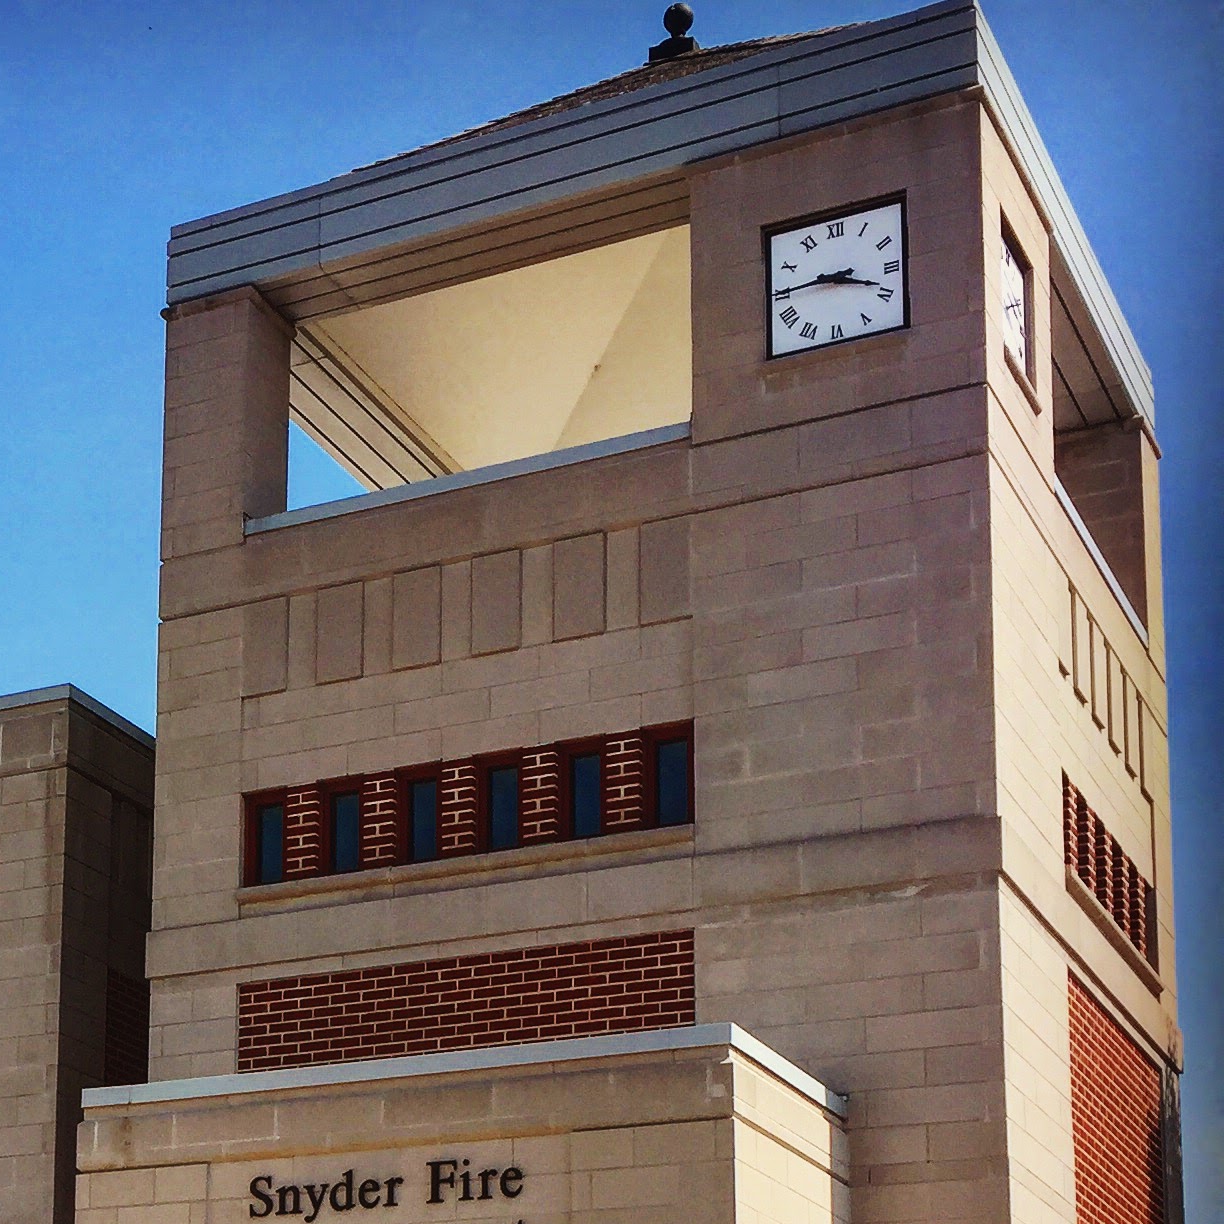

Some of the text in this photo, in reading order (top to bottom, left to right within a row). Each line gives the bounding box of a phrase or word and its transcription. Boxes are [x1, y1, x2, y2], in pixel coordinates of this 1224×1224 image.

[827, 221, 844, 239] XII
[858, 222, 868, 237] I
[800, 235, 818, 253] XI
[876, 235, 892, 251] II
[781, 261, 798, 273] X
[884, 260, 900, 275] III
[877, 287, 894, 302] IV
[779, 305, 800, 329] VIII
[860, 312, 872, 326] V
[799, 322, 818, 340] VII
[831, 324, 844, 339] VI
[249, 1158, 524, 1223] Snyder Fire
